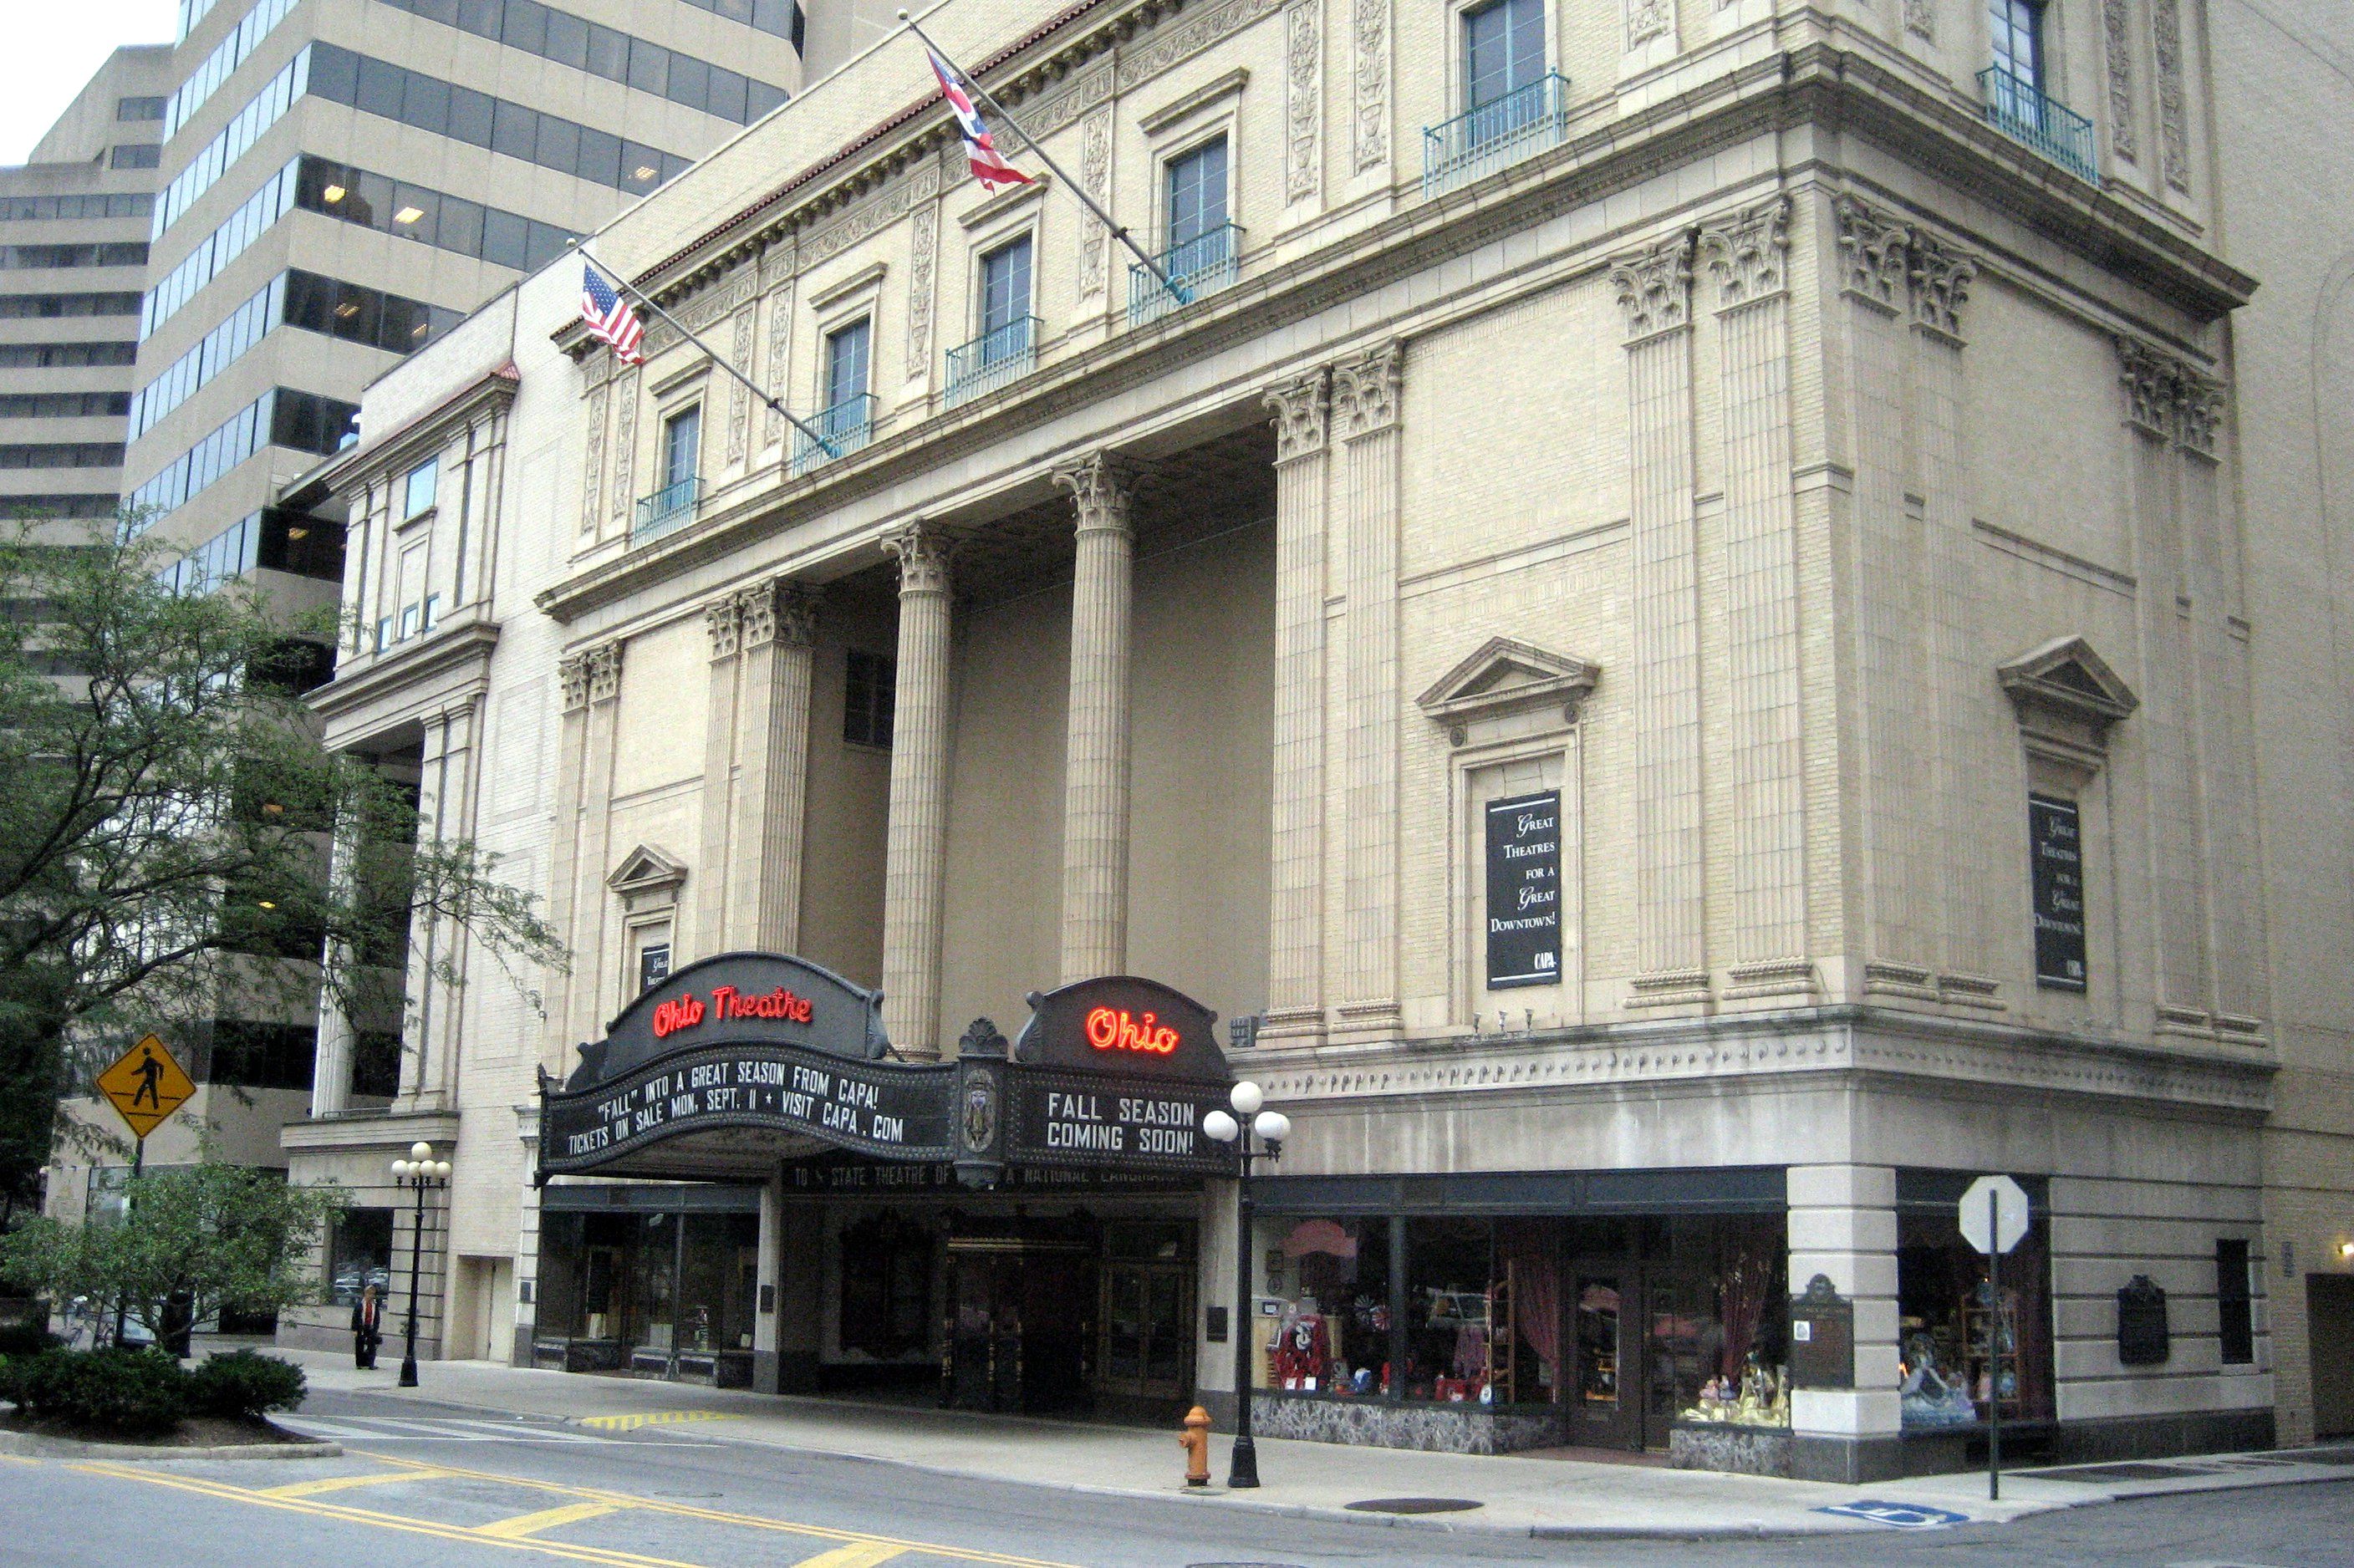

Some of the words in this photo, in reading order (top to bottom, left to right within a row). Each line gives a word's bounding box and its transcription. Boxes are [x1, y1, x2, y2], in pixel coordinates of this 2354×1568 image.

[1516, 813, 1554, 837] GREAT
[1504, 842, 1555, 858] THEATRES
[1526, 868, 1544, 879] FOR
[1548, 867, 1555, 876] A
[1517, 886, 1555, 910] GREAT
[1490, 912, 1556, 932] DOWNTOWN!
[1534, 952, 1557, 970] CAPA
[653, 992, 706, 1038] Ohio
[711, 985, 813, 1024] Theatre
[1087, 1005, 1179, 1054] Ohio
[645, 1076, 669, 1103] INTO
[676, 1071, 684, 1092] A
[691, 1062, 729, 1088] GREAT
[737, 1061, 785, 1086] SEASON
[792, 1066, 829, 1097] FROM
[838, 1078, 879, 1110] CAPA!
[568, 1127, 609, 1155] TICKETS
[615, 1117, 629, 1140] ON
[636, 1102, 664, 1132] SALE
[706, 1087, 741, 1111] SEPT.
[782, 1091, 814, 1119] VISIT
[1048, 1092, 1103, 1121] FALL
[1118, 1097, 1195, 1127] SEASON
[1047, 1122, 1123, 1151] COMING
[1139, 1128, 1194, 1155] SOON!
[832, 1167, 866, 1186] STATE
[874, 1165, 926, 1185] THEATRE
